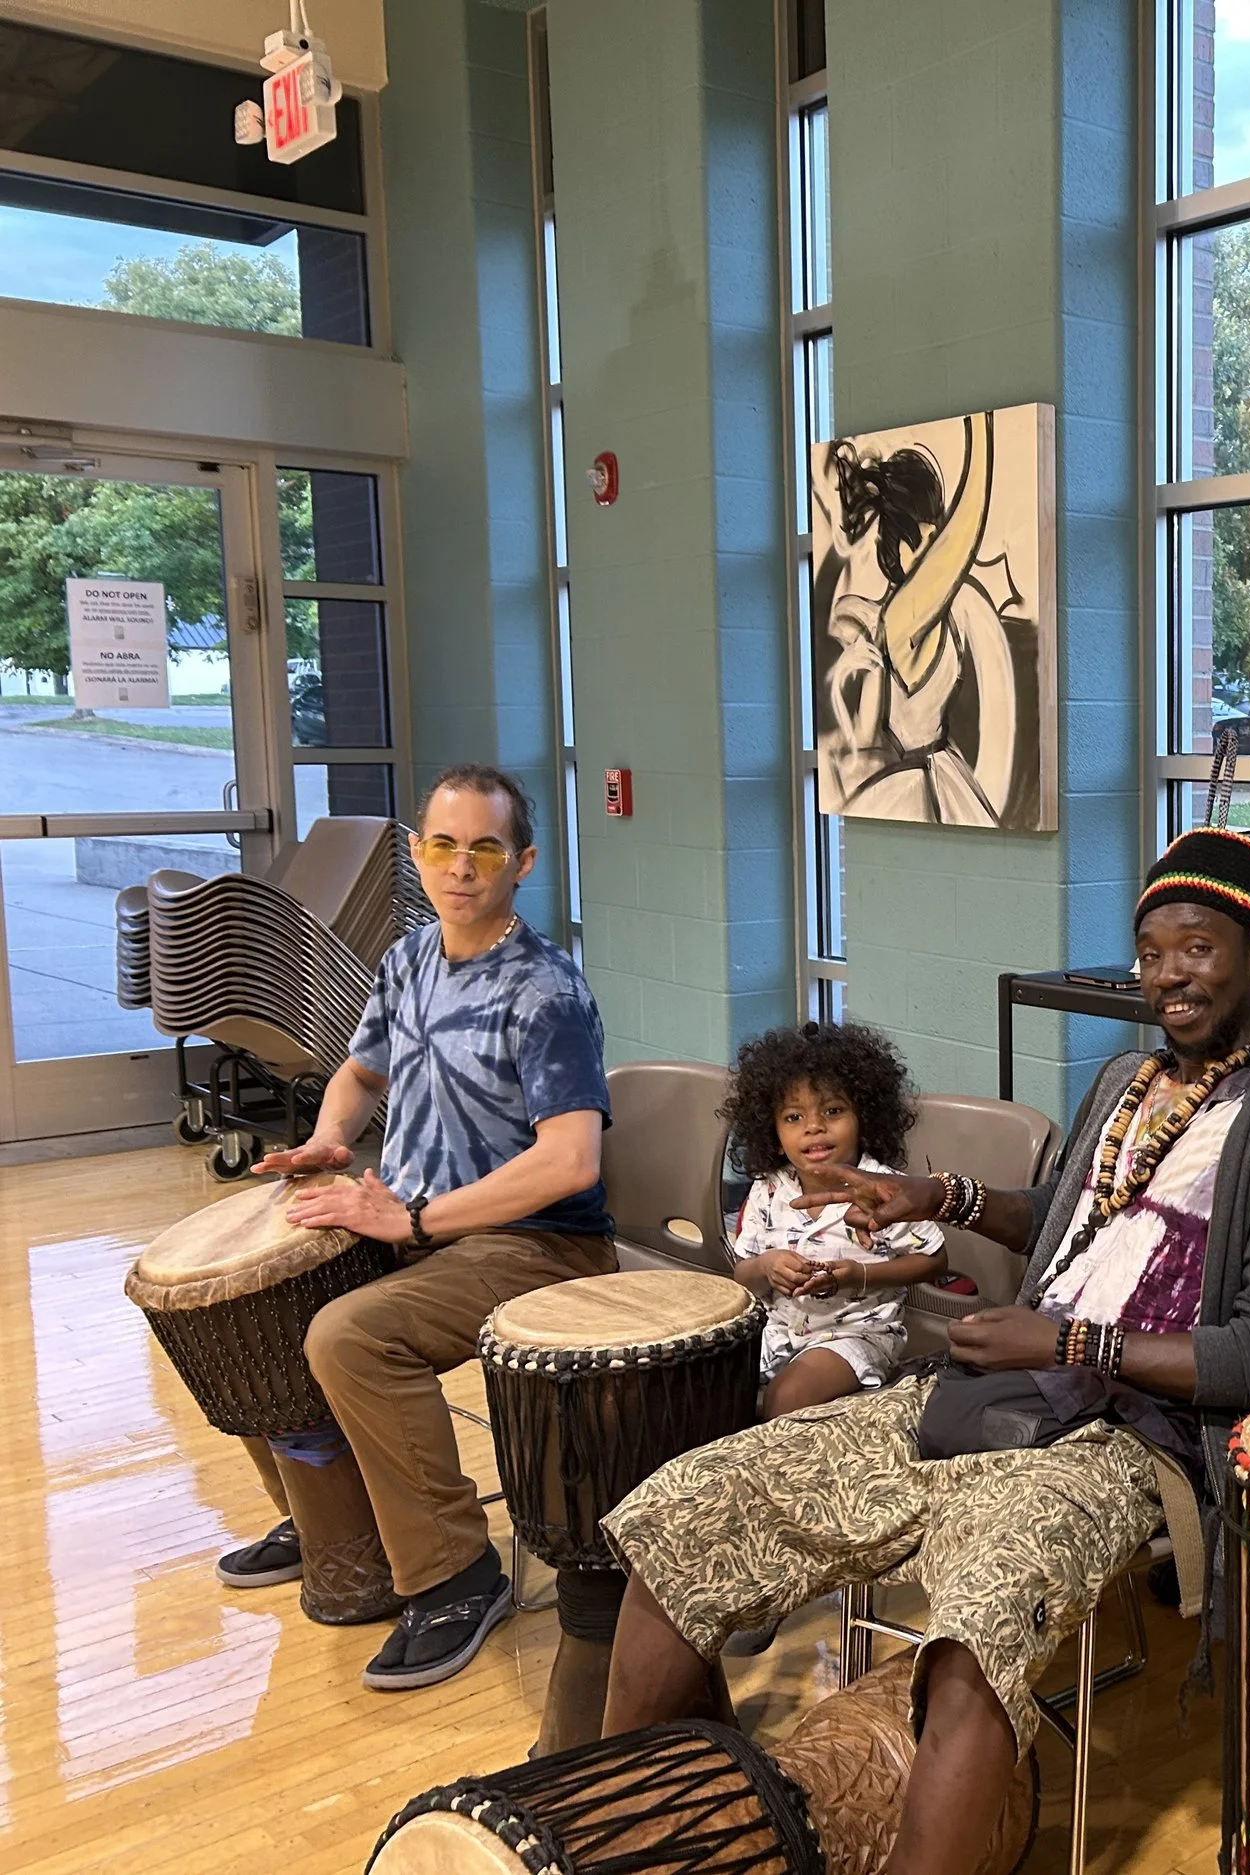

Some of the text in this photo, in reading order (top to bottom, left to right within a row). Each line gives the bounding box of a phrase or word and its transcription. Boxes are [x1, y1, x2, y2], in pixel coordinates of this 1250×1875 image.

[85, 590, 147, 600] DO NOT OPEN
[100, 652, 141, 660] NO ABRA
